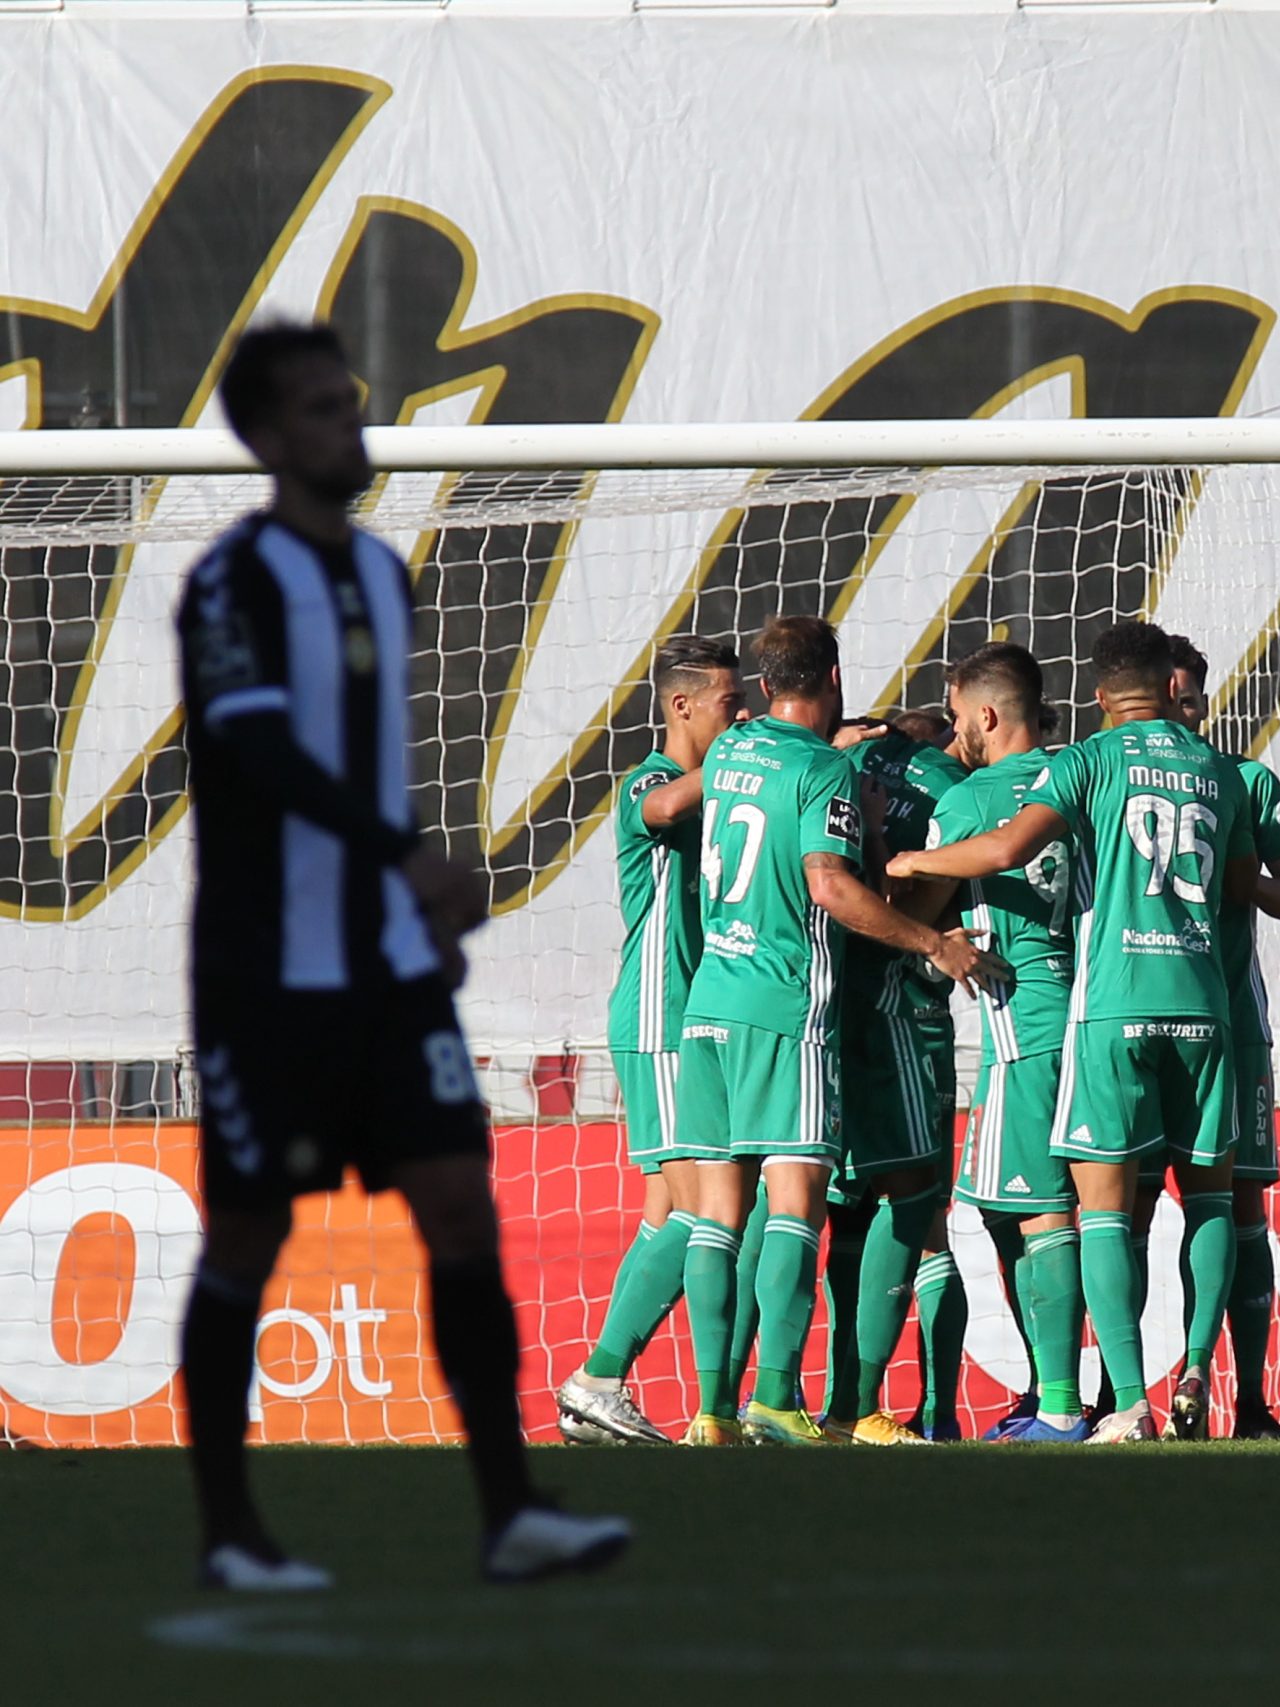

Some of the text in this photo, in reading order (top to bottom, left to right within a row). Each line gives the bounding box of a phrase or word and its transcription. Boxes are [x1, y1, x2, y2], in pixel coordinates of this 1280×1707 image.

[712, 767, 764, 797] LUCCA
[1128, 765, 1219, 801] MANCHA
[700, 796, 767, 904] 47
[1125, 793, 1217, 903] 95
[1122, 1022, 1216, 1039] BF SECURITY
[1255, 1084, 1267, 1147] CARS
